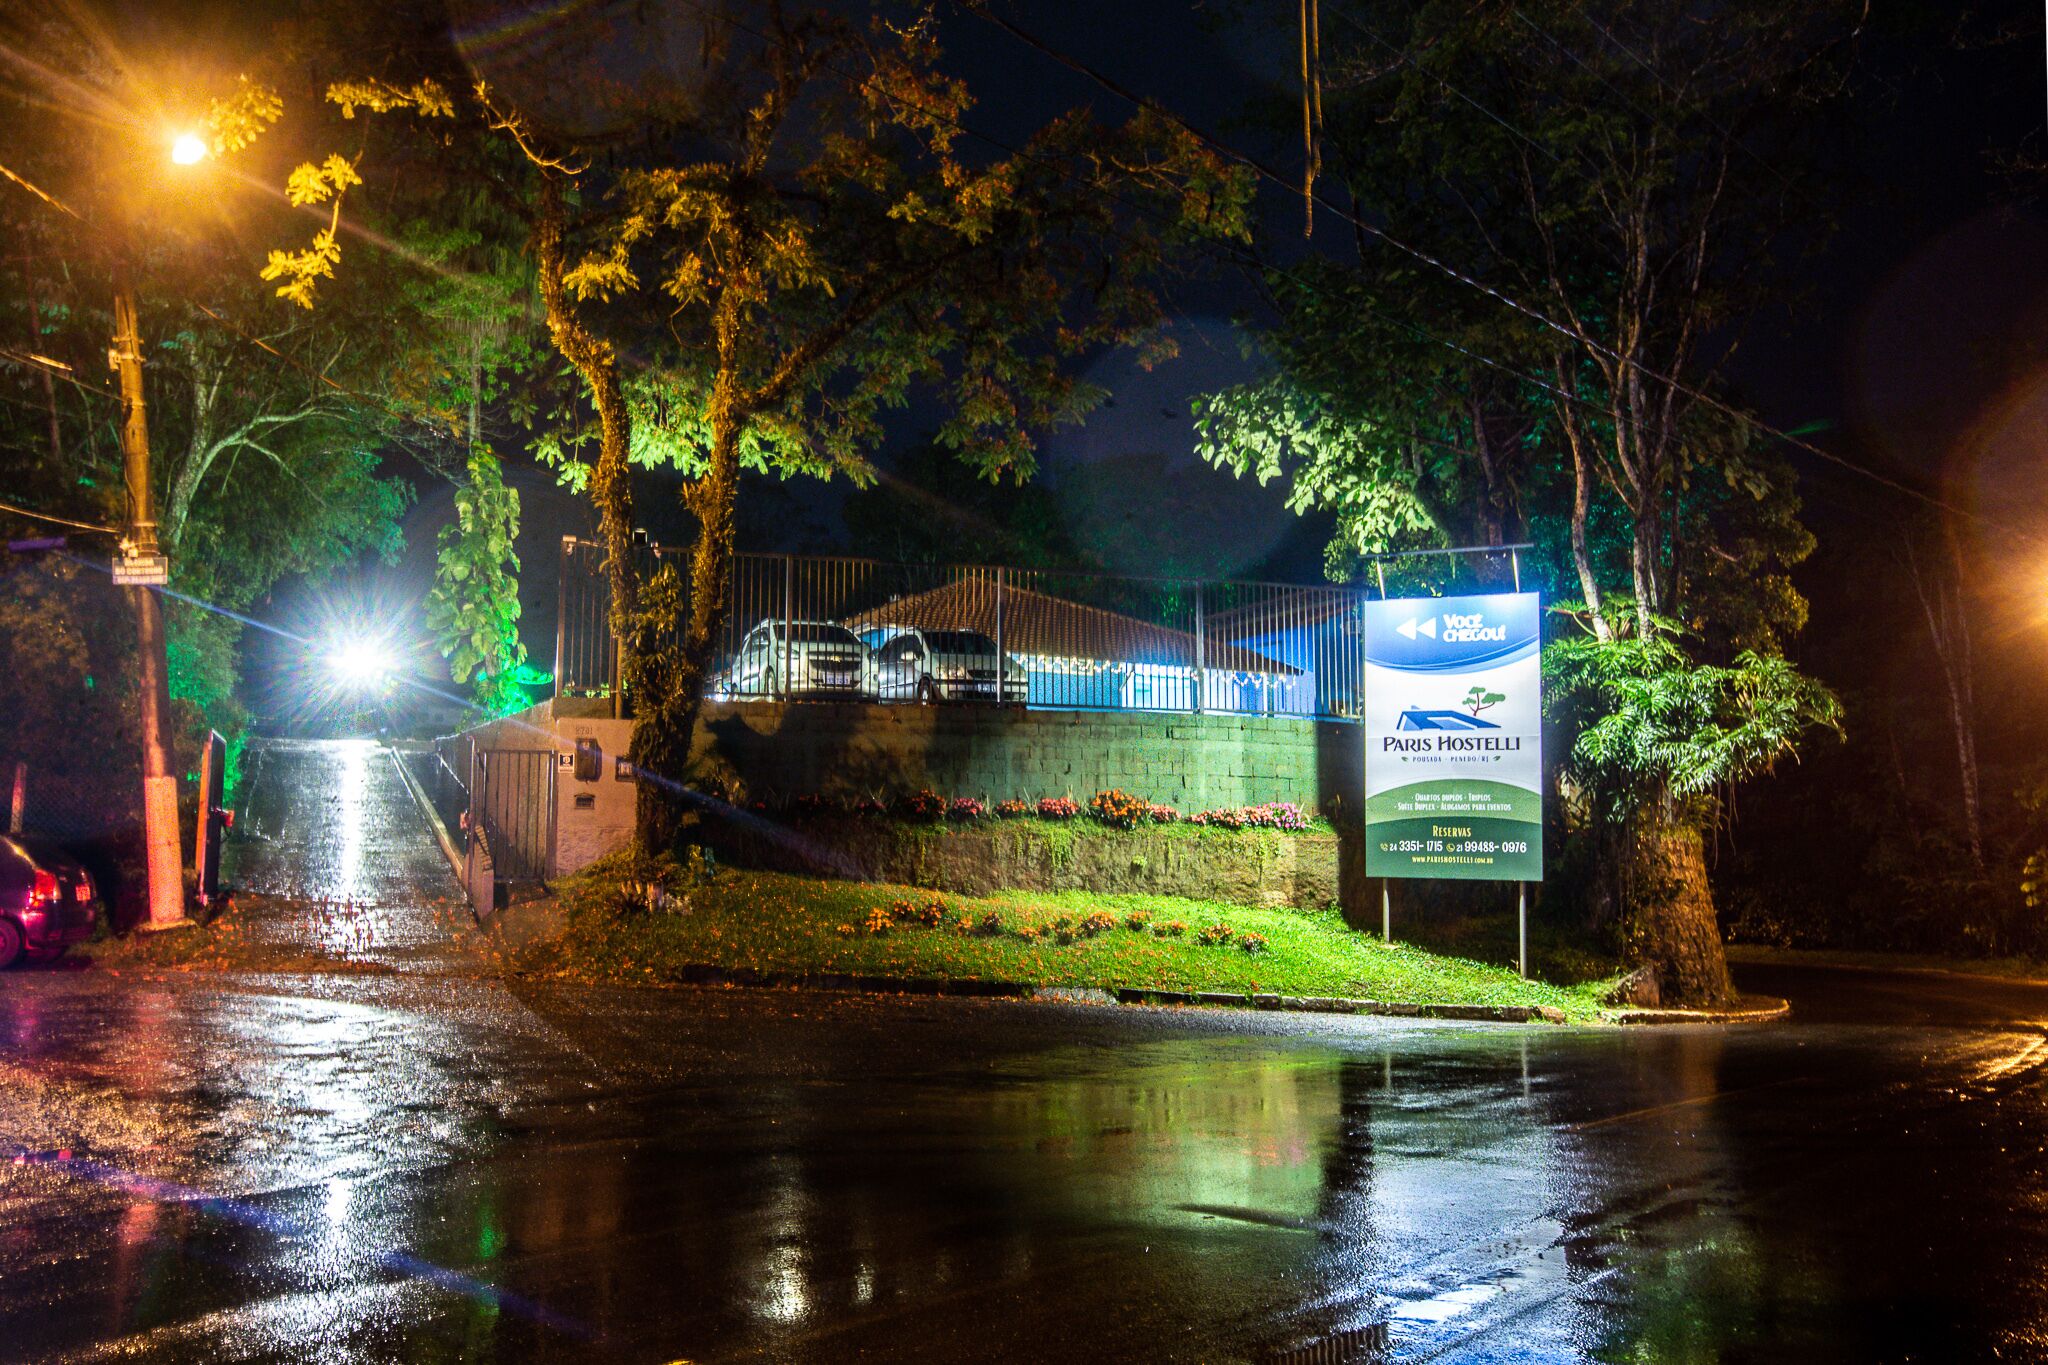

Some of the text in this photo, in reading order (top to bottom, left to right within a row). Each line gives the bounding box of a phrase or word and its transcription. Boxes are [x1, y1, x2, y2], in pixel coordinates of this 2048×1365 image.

[1442, 625, 1506, 643] CHEGOU!
[1383, 736, 1521, 752] PARIS HOSTELLI
[1432, 825, 1472, 838] RESERVAS
[1389, 843, 1398, 851] 24
[1426, 841, 1443, 852] 1715
[1456, 844, 1463, 852] 21
[1502, 842, 1527, 853] 0976
